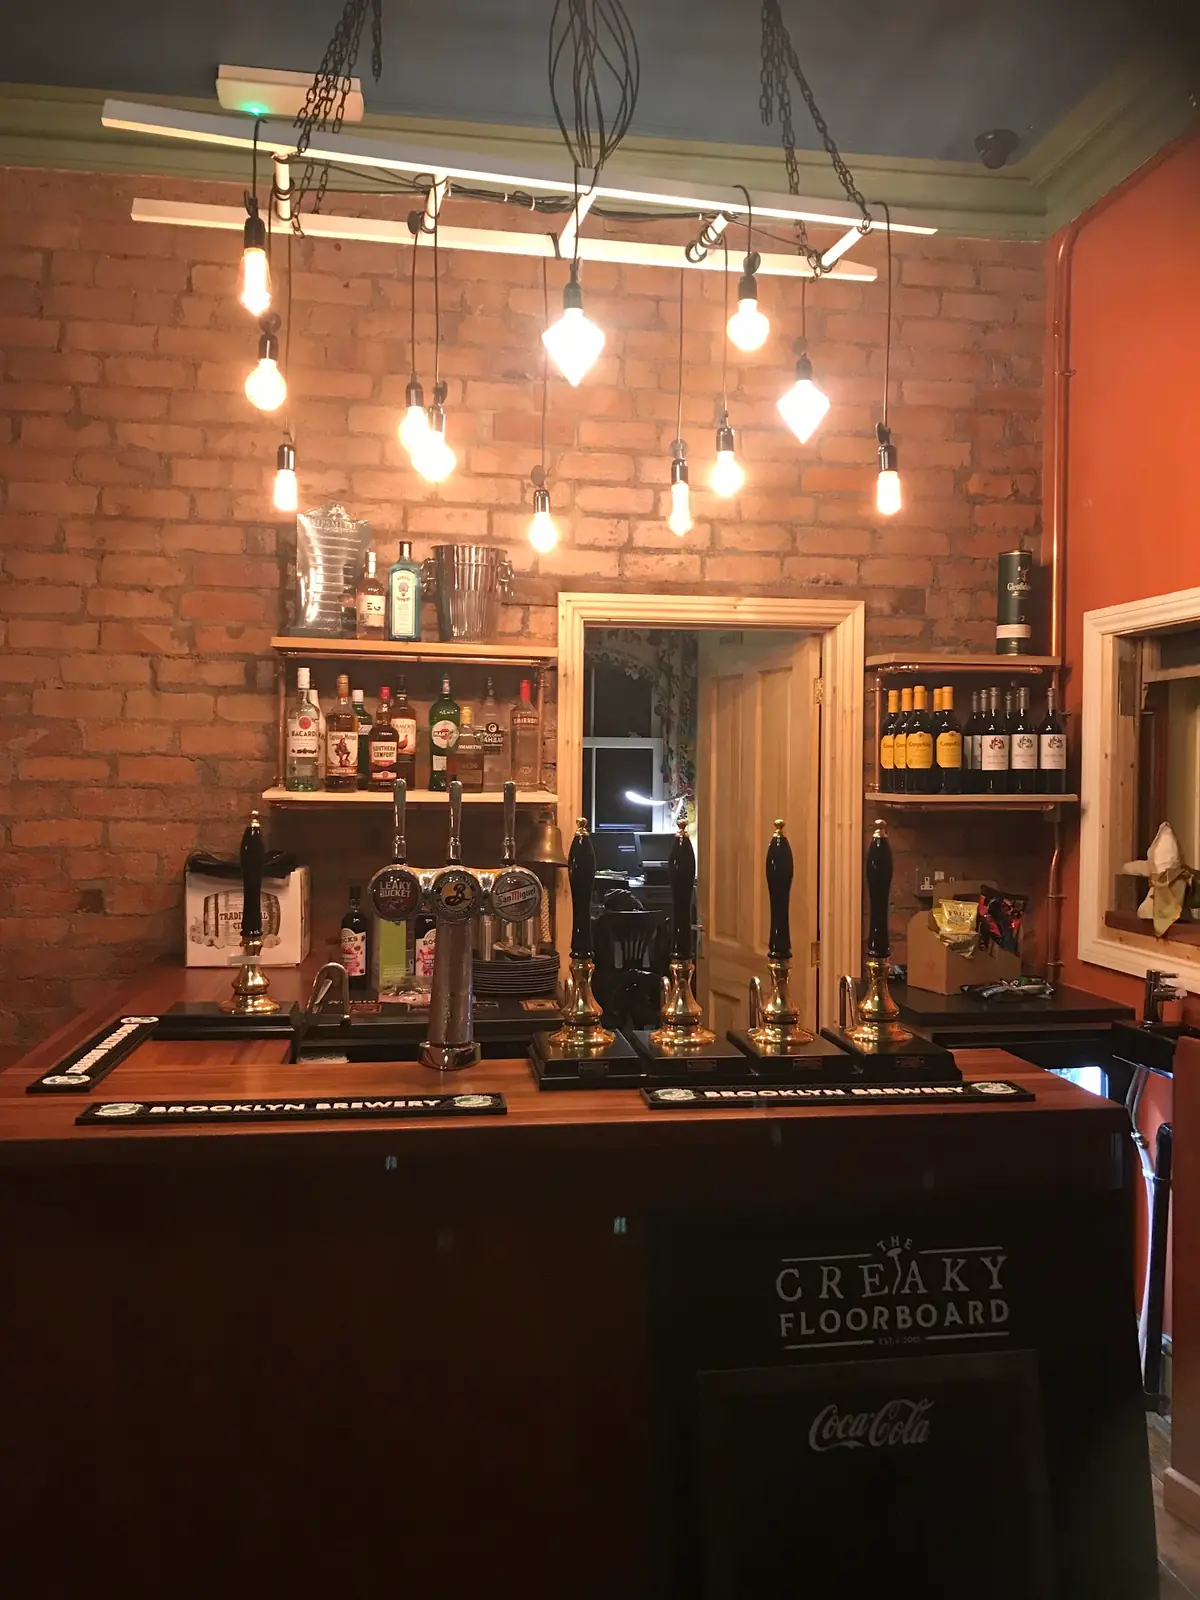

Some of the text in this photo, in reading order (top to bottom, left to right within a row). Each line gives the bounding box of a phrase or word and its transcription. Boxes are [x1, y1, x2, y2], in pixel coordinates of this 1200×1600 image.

[379, 881, 412, 891] LEAKY
[379, 889, 412, 898] BUCKET
[219, 911, 269, 921] TRADIL
[704, 1086, 965, 1099] BROOKLYN BREWERY
[149, 1099, 441, 1113] BROOKLYN BREWERY
[876, 1235, 913, 1252] THE
[775, 1254, 1008, 1302] CREAKY
[779, 1298, 1010, 1338] FLOORBOARD
[808, 1397, 935, 1452] Coca-Cola
